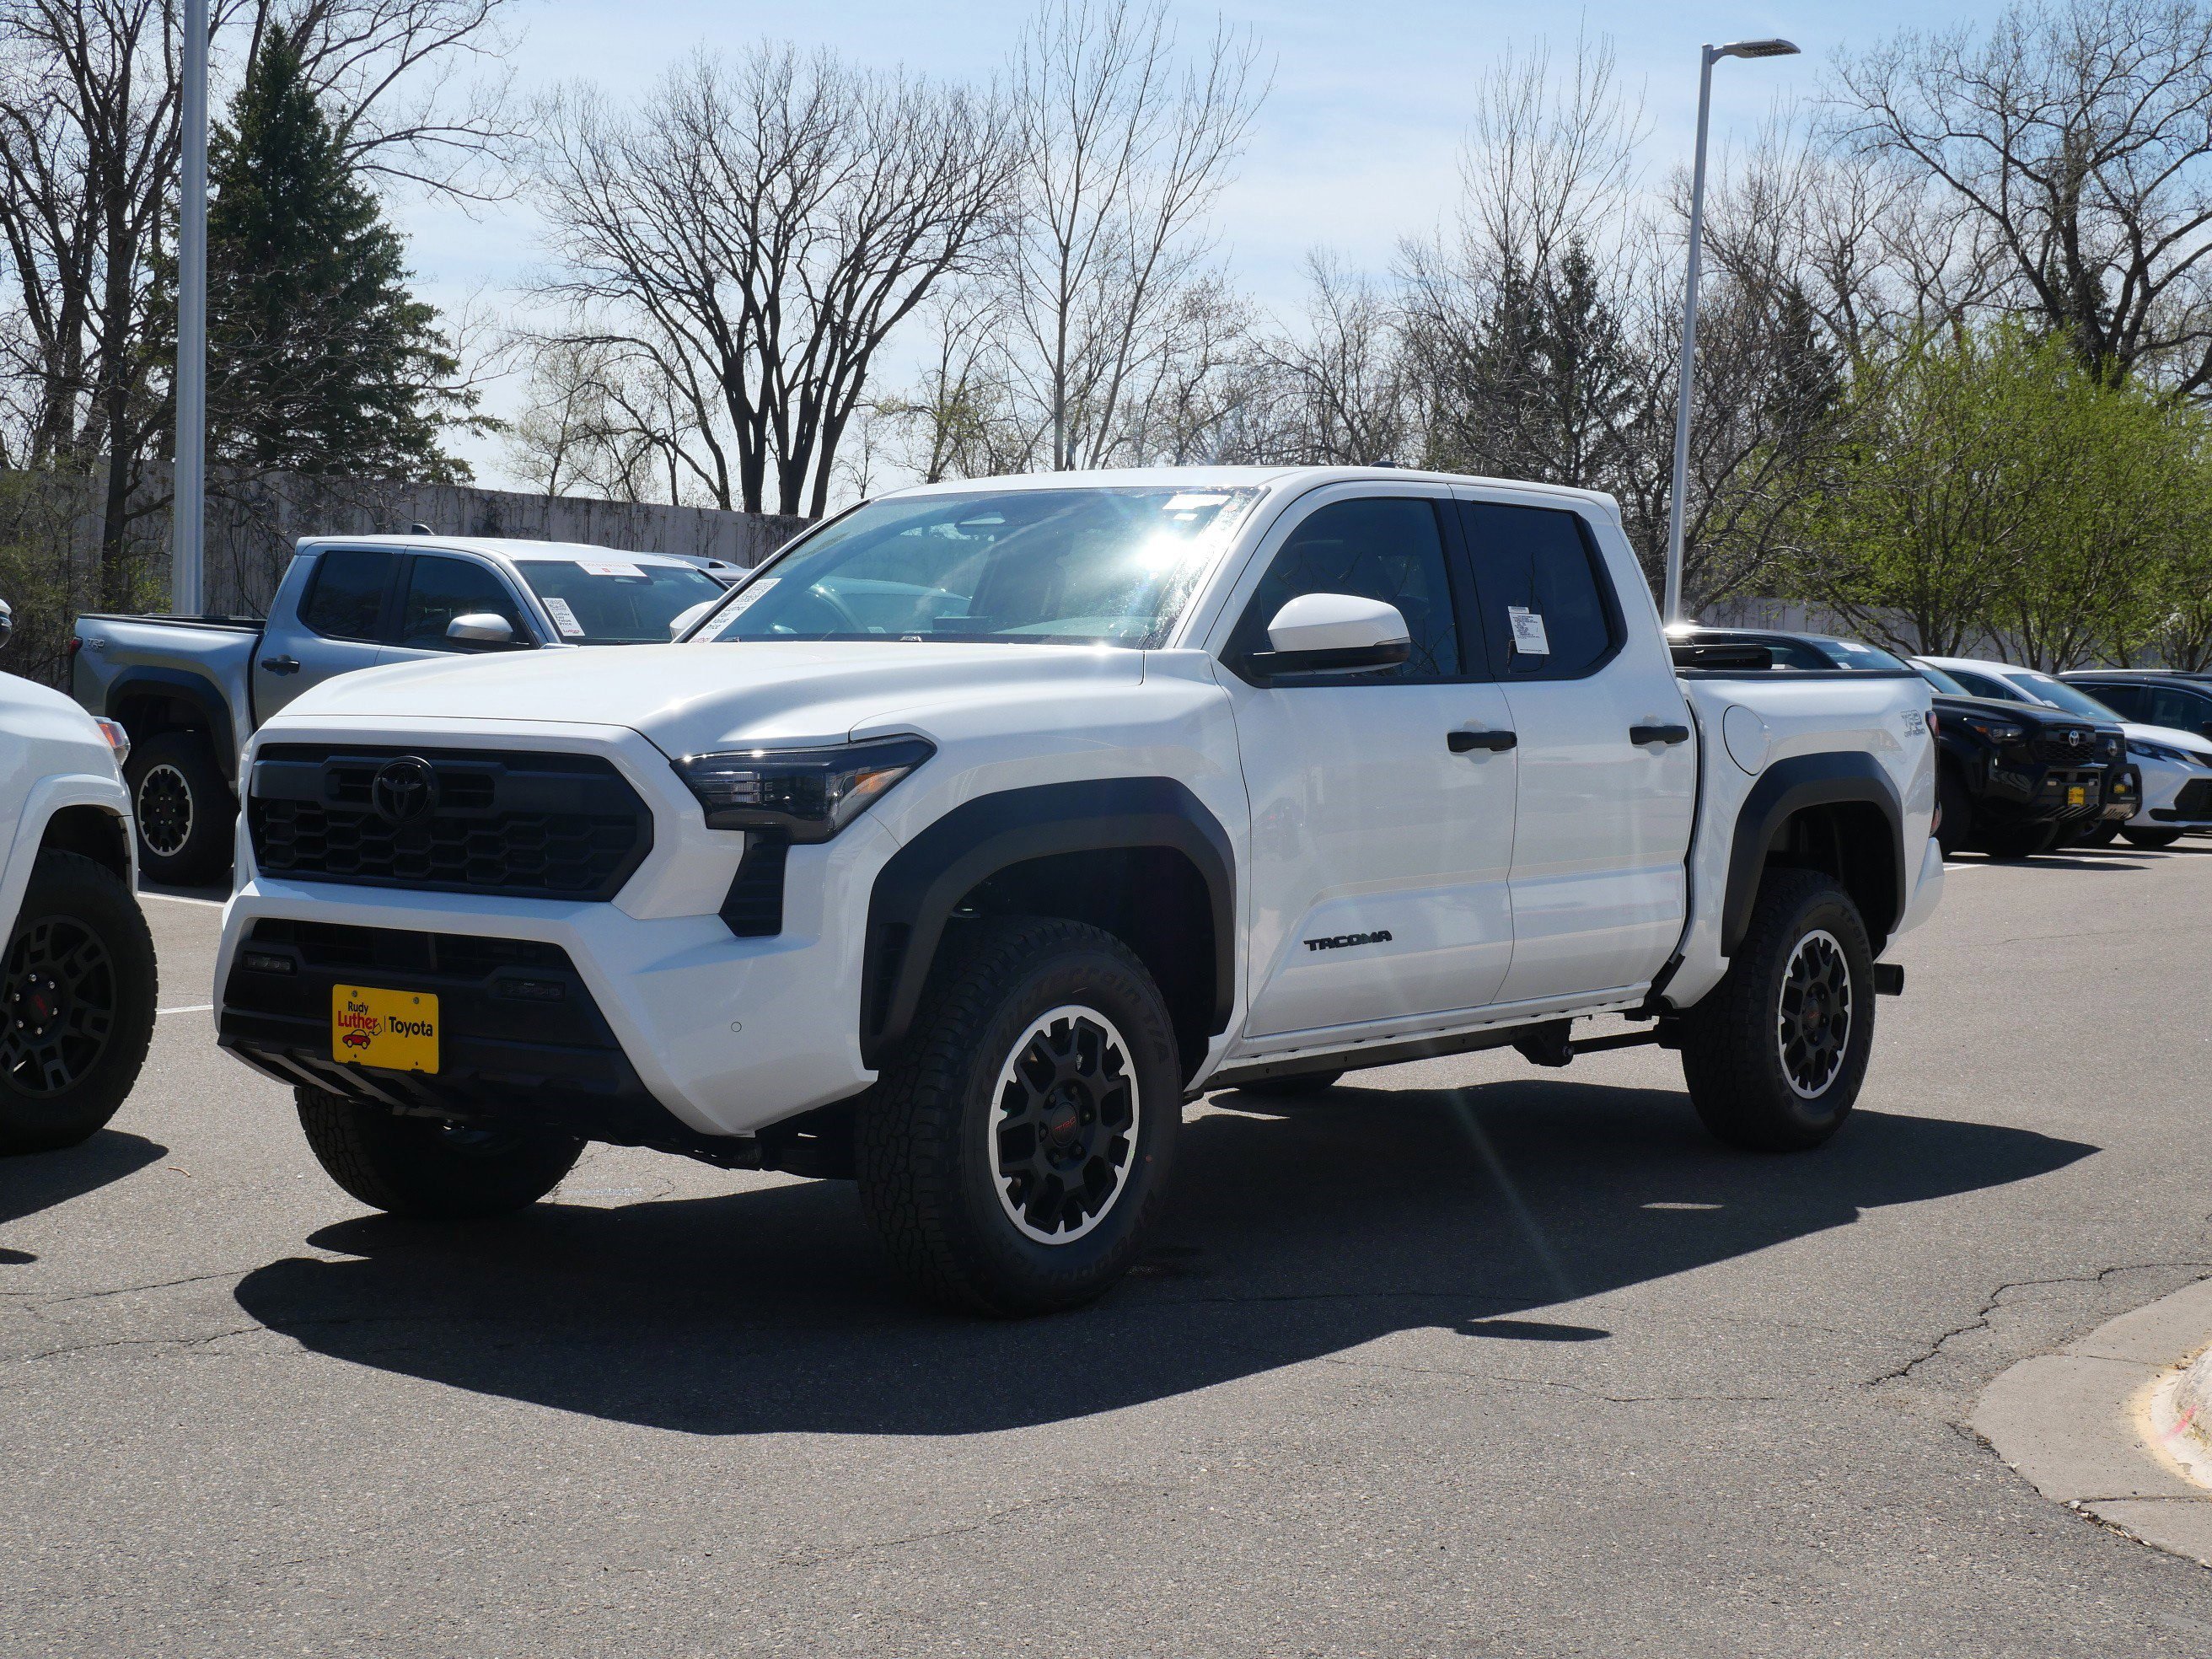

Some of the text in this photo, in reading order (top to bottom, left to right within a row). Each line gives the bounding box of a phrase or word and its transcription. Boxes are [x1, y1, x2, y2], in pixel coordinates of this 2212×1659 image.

[88, 638, 105, 649] TRD
[1900, 709, 1923, 731] TRD
[1303, 930, 1393, 951] TACOMA
[347, 1001, 368, 1015] Rudy
[338, 1011, 378, 1030] Luther
[389, 1016, 433, 1038] Toyota
